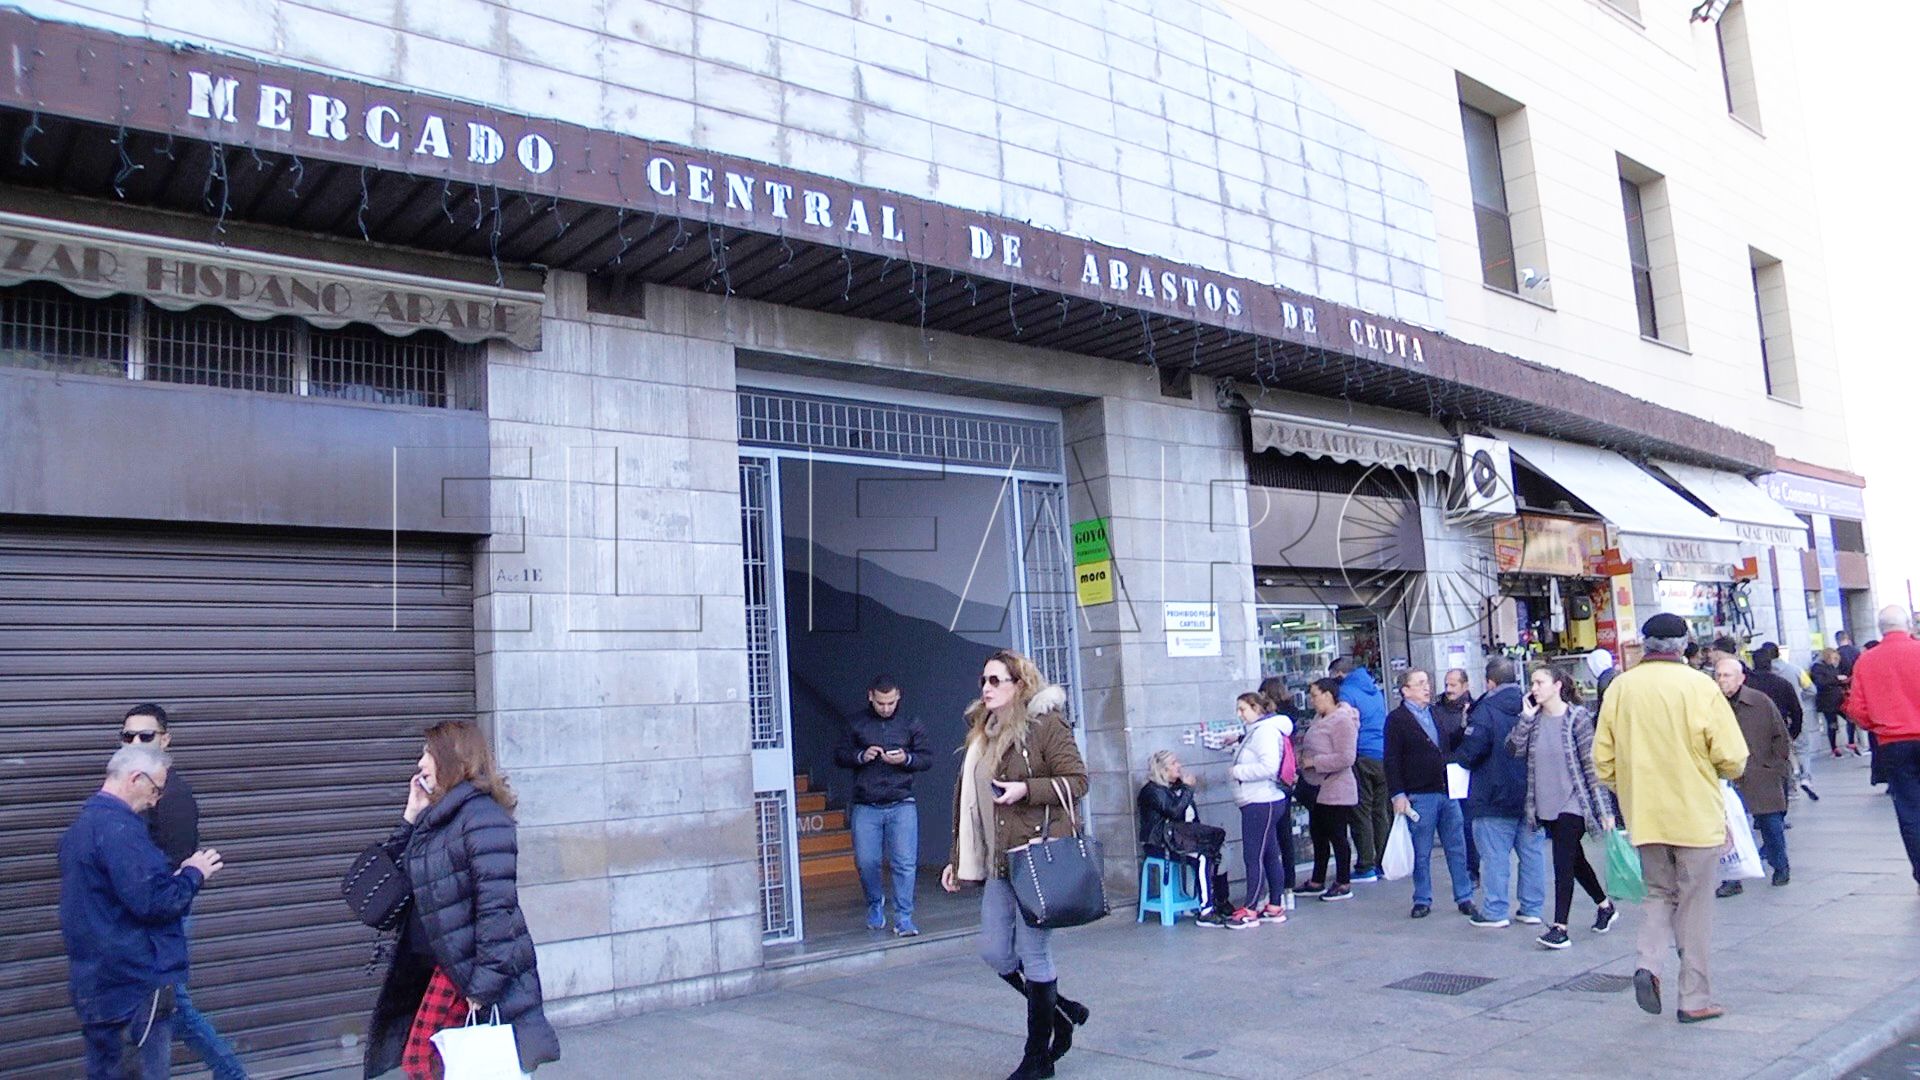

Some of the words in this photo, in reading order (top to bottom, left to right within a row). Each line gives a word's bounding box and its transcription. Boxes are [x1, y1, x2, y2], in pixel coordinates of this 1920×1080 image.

[187, 70, 555, 175] MERCADO
[646, 156, 904, 242] CENTRAL
[968, 225, 1023, 268] DE
[1081, 254, 1242, 316] ABASTOS
[1281, 302, 1317, 334] DE
[1350, 318, 1425, 363] CEUTA
[0, 234, 123, 284] ZAR
[146, 255, 353, 315] HISPANO
[375, 289, 517, 336] ARABE
[1075, 527, 1105, 545] GOYO
[1080, 570, 1106, 584] mora
